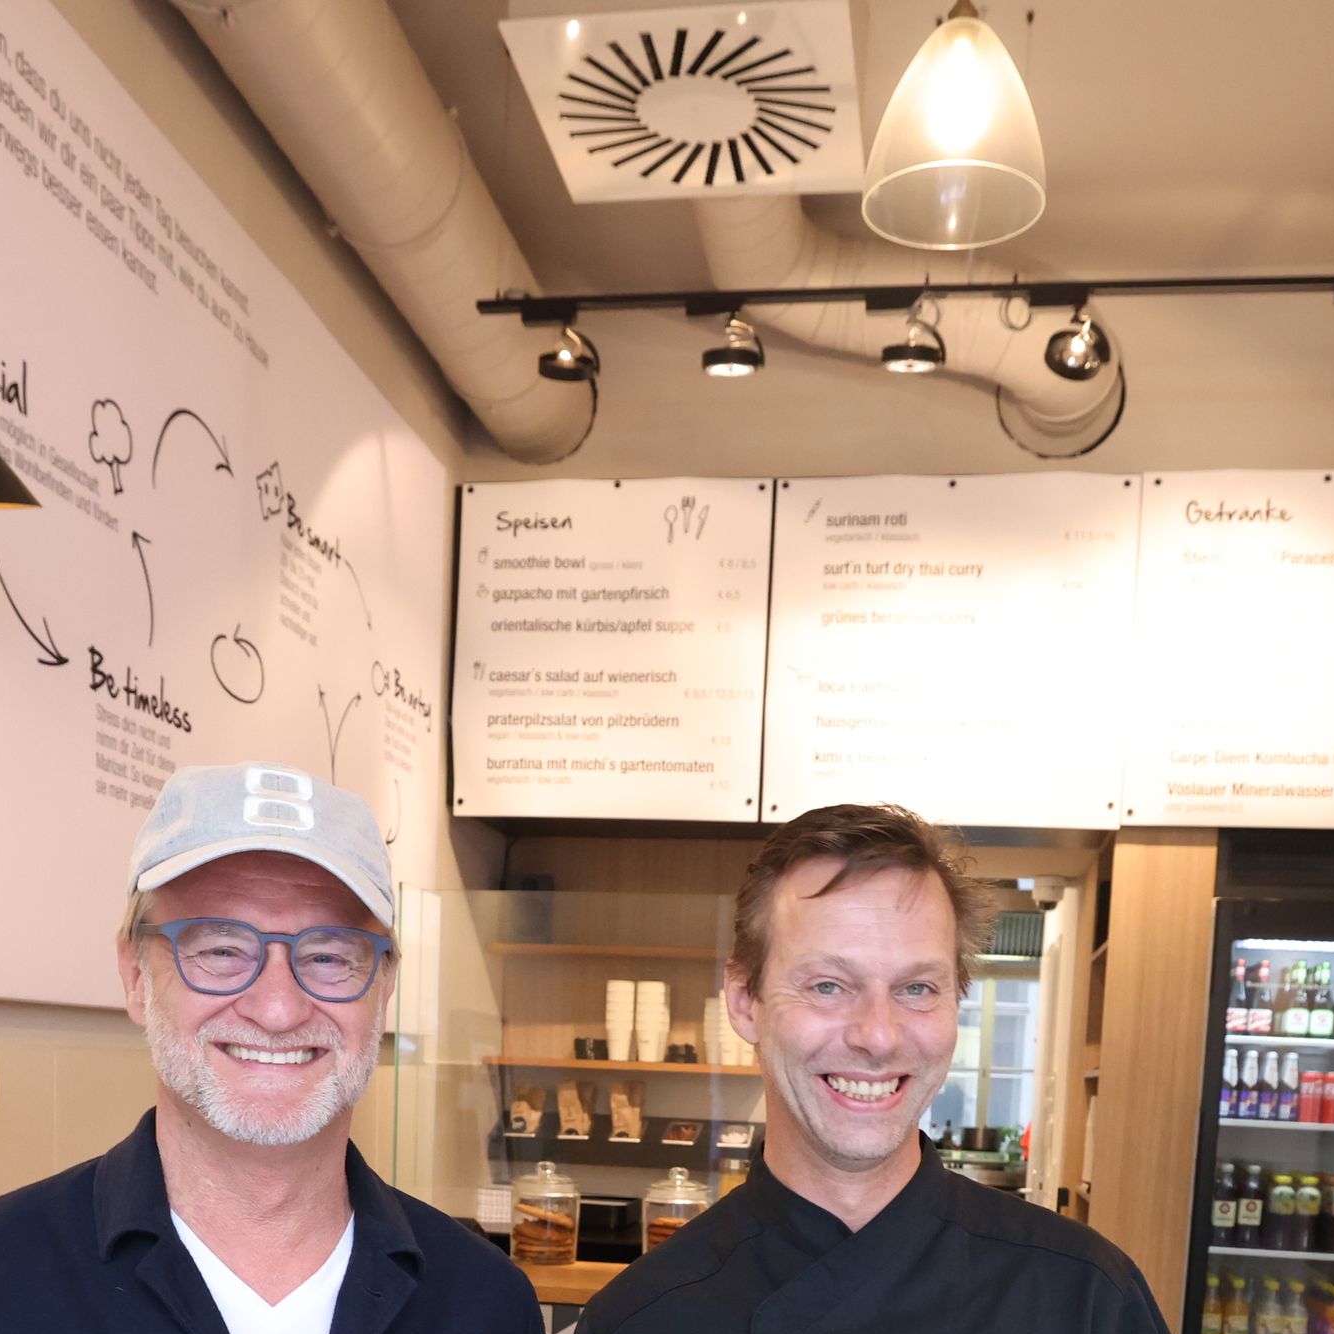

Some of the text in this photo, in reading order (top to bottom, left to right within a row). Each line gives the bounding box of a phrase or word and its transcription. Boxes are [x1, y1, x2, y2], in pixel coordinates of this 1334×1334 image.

[49, 88, 66, 121] du
[38, 118, 57, 152] wir
[60, 141, 77, 172] dir
[80, 162, 99, 195] ein
[100, 184, 126, 222] paar
[42, 158, 83, 220] besser
[85, 209, 119, 256] essen
[496, 510, 573, 538] Speisen
[826, 511, 908, 527] surinam roti
[285, 491, 304, 538] Be
[307, 527, 341, 567] smart
[494, 555, 551, 569] smoothie
[554, 555, 586, 569] bowl
[866, 561, 890, 575] turf
[893, 561, 915, 578] dry
[919, 562, 944, 575] thai
[948, 563, 984, 578] curry
[492, 586, 553, 604] gazpacho
[556, 586, 577, 600] mit
[580, 586, 670, 604] gartenpfirsich
[490, 618, 695, 635] orientalische kürbis/apfel suppe
[821, 610, 867, 627] grünes
[545, 669, 579, 682] salad
[583, 669, 604, 682] auf
[607, 668, 677, 683] wienerisch
[88, 645, 192, 733] Be timeless
[487, 712, 680, 729] praterpilzsalat von pilzbrüdern
[486, 757, 543, 770] burratina
[546, 757, 567, 770] mit
[619, 759, 715, 774] gartentomaten
[1254, 751, 1330, 765] Kombucha
[1231, 782, 1334, 797] Mineralwasser
